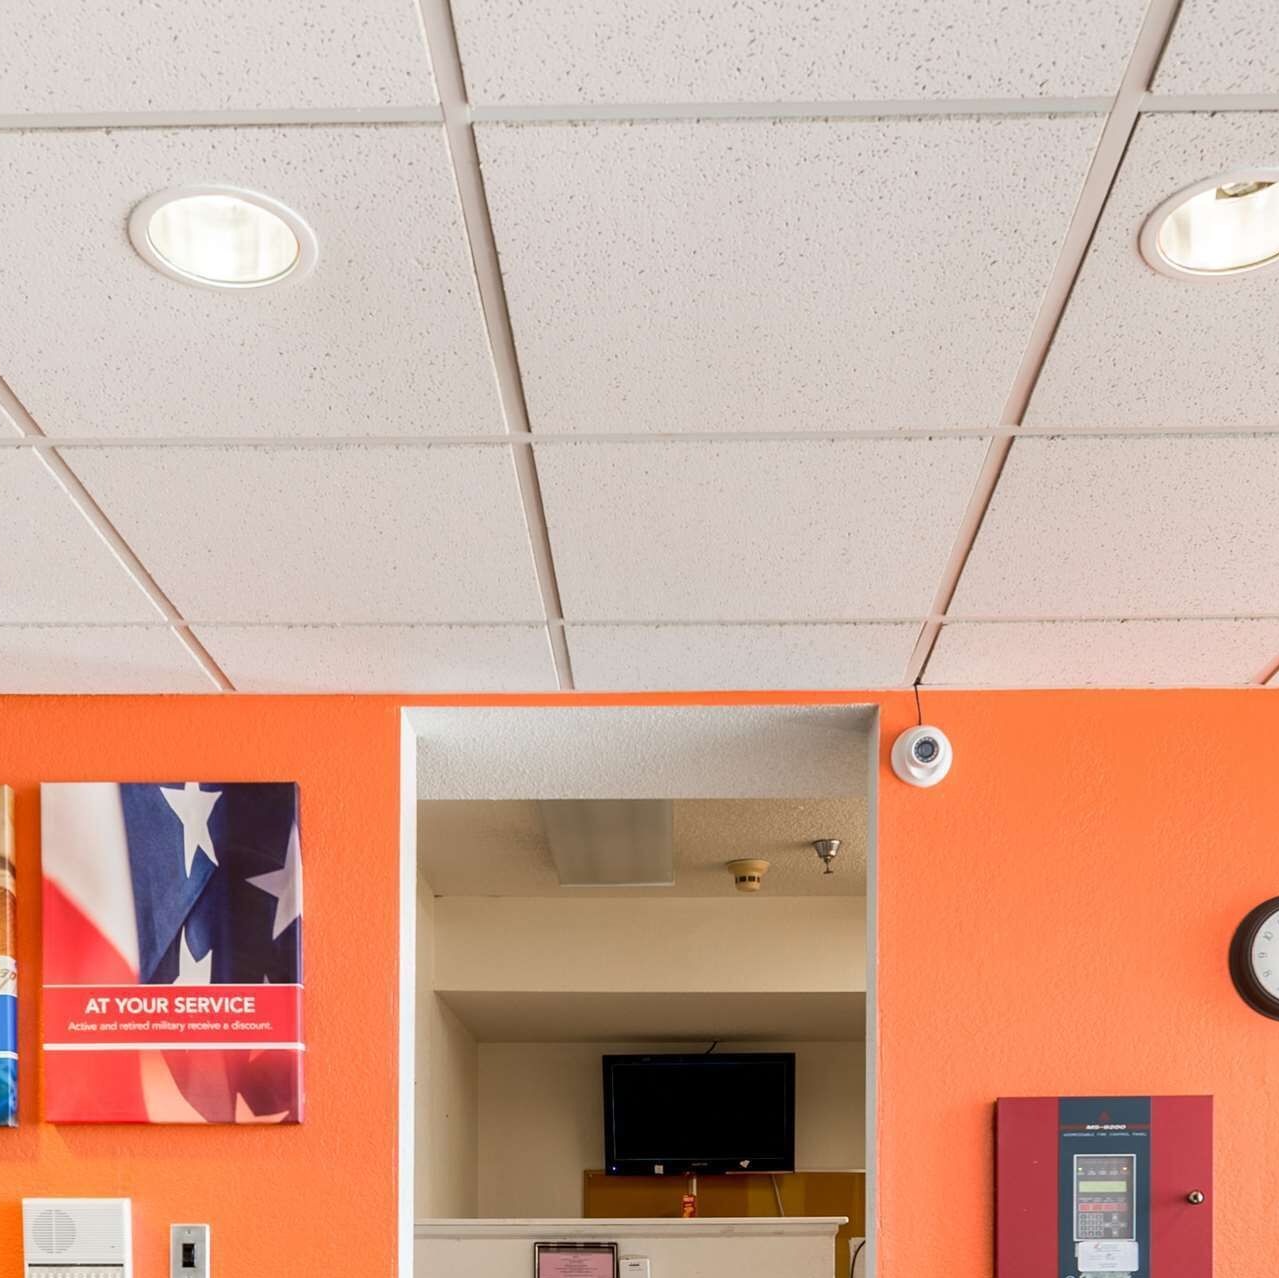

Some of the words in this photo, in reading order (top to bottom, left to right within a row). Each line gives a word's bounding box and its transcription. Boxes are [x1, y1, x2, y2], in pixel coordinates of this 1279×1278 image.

[84, 998, 110, 1014] AT
[115, 997, 169, 1014] YOUR
[174, 997, 256, 1014] SERVICE
[68, 1022, 97, 1031] Active
[100, 1022, 117, 1031] and
[120, 1021, 150, 1031] retired
[152, 1021, 185, 1032] military
[187, 1021, 221, 1031] receive
